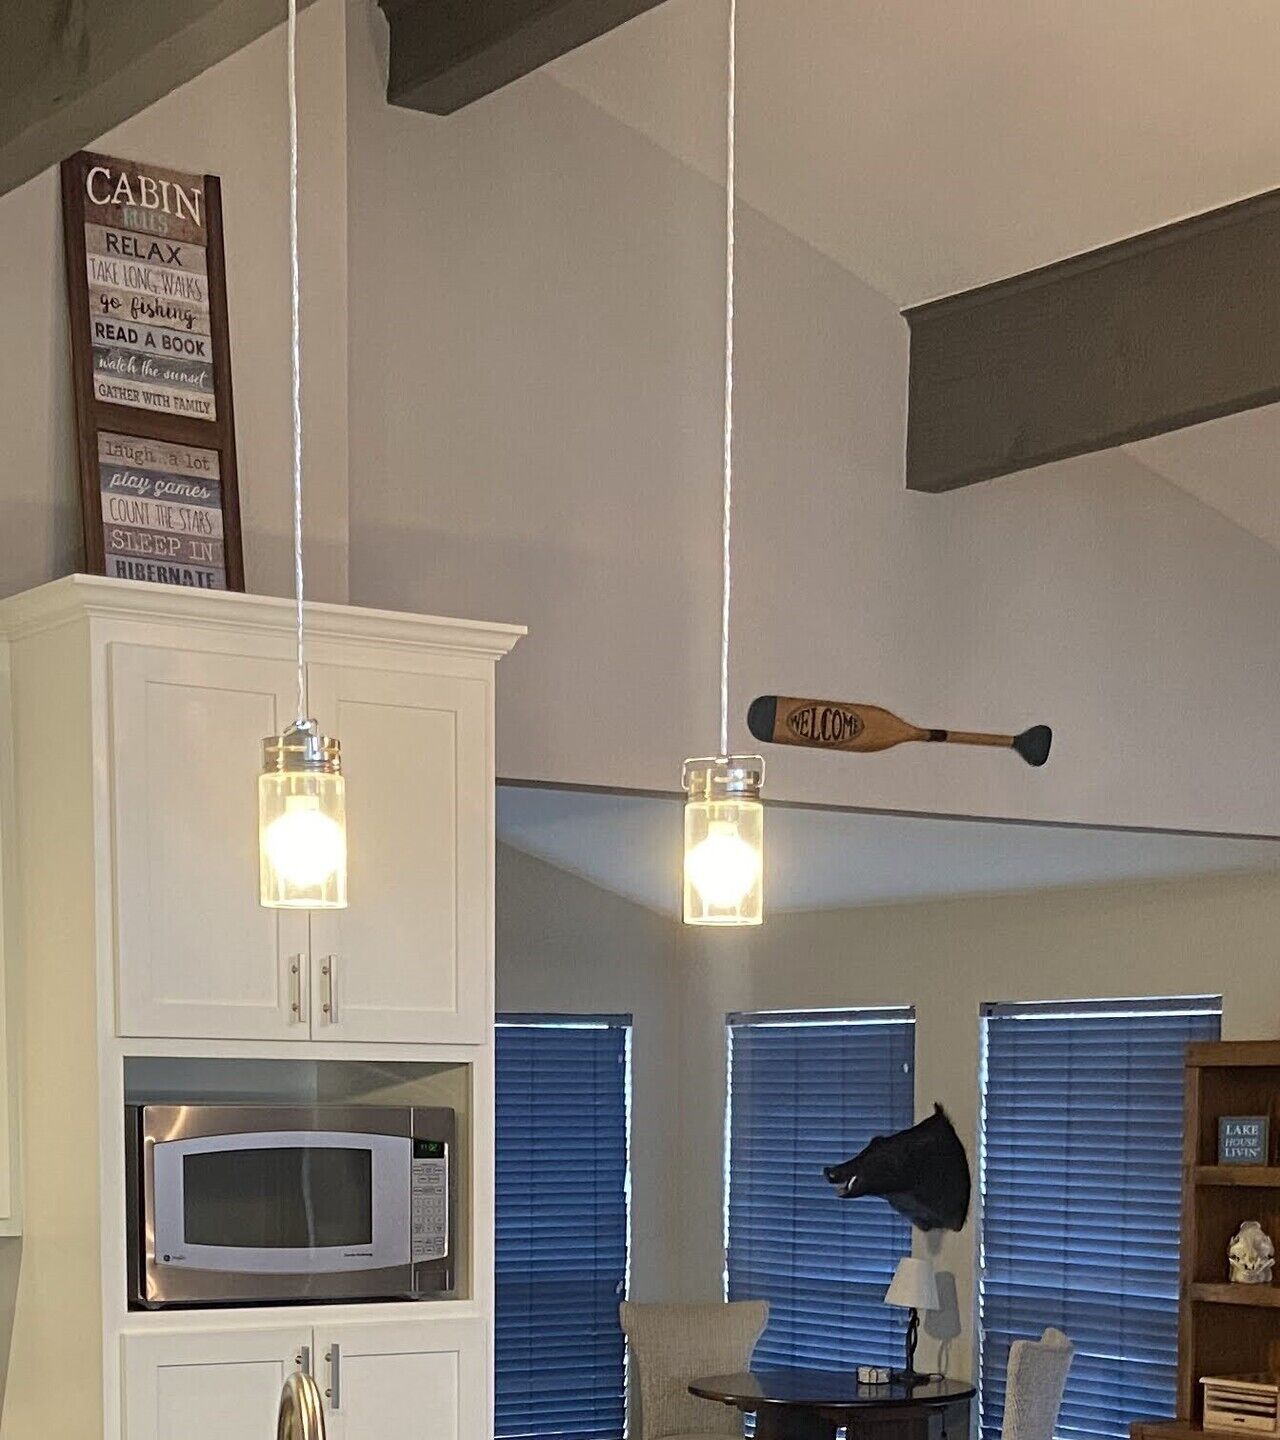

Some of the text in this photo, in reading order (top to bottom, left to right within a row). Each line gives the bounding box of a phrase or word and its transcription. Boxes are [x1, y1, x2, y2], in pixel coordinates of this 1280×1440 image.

[86, 166, 202, 227] CABIN
[106, 232, 183, 266] RELAX
[89, 257, 203, 301] TAKE LONG WALKS
[100, 292, 197, 329] go fishing
[95, 322, 205, 356] READ A BOOK
[98, 354, 209, 387] watch the sunset
[99, 384, 212, 415] GATHER WITH FAMILY
[105, 440, 211, 471] laugh a lot
[109, 471, 212, 499] play games
[109, 497, 213, 534] COUNT THE STARS
[111, 529, 214, 562] SLEEP IN
[115, 559, 214, 588] HIBERNATE
[790, 707, 858, 741] WELCOME
[1224, 1137, 1258, 1147] HOUSE
[1225, 1124, 1259, 1136] LAKE
